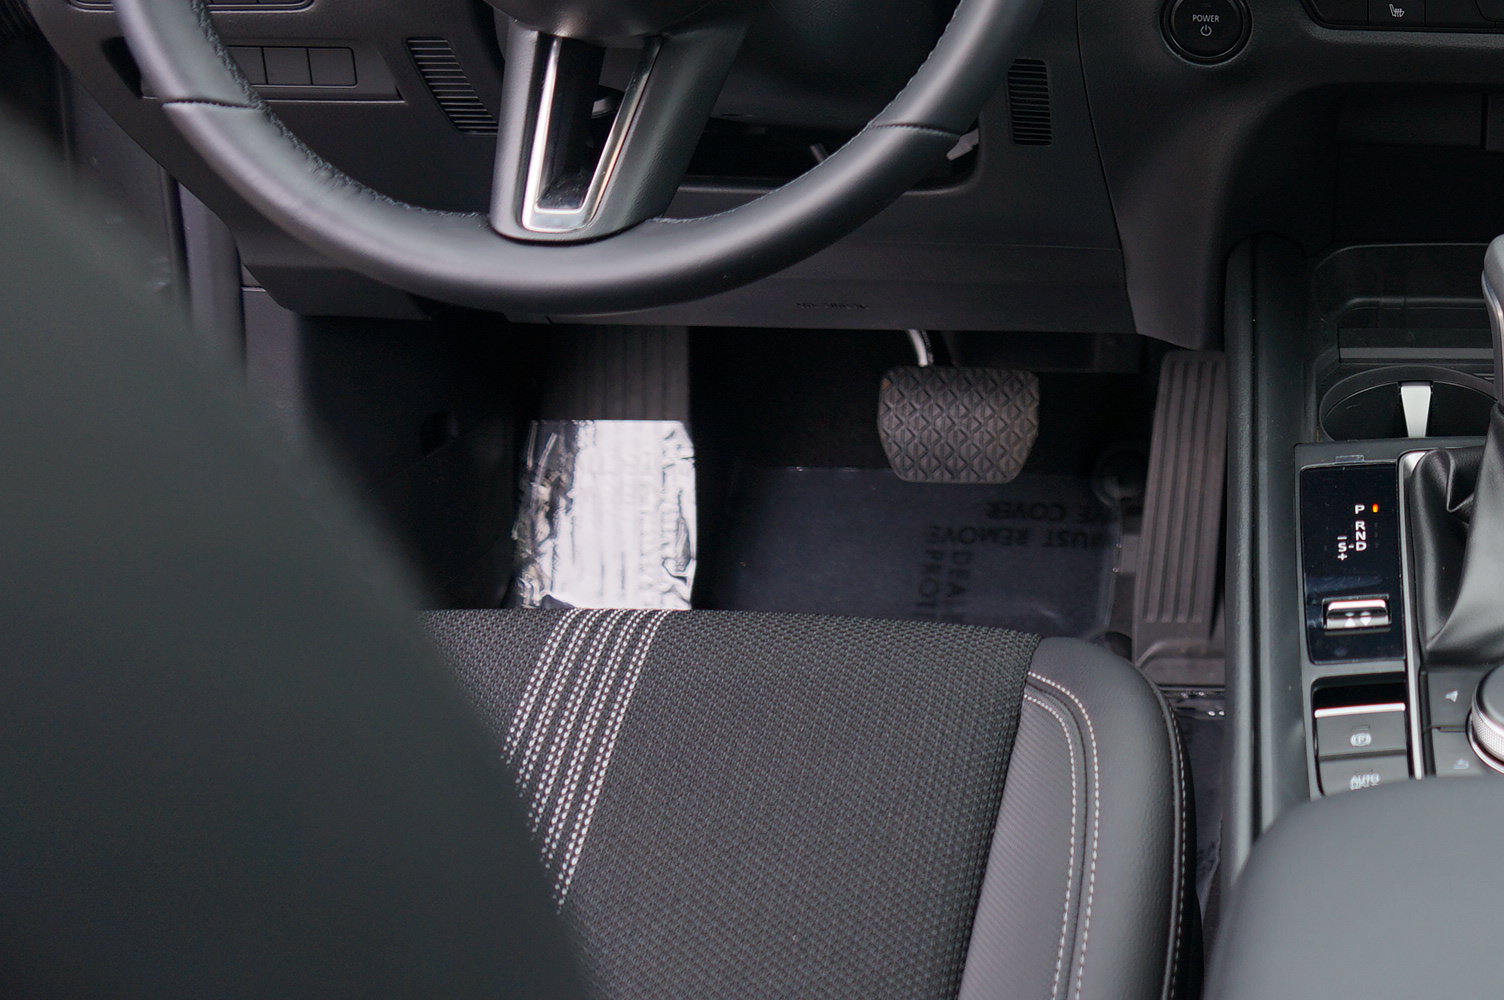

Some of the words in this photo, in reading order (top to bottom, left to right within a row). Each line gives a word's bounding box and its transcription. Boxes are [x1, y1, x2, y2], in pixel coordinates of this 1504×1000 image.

[1192, 14, 1220, 23] POWER
[1355, 504, 1365, 514] P
[1355, 520, 1366, 531] R
[1355, 531, 1366, 541] N
[1356, 541, 1367, 551] D
